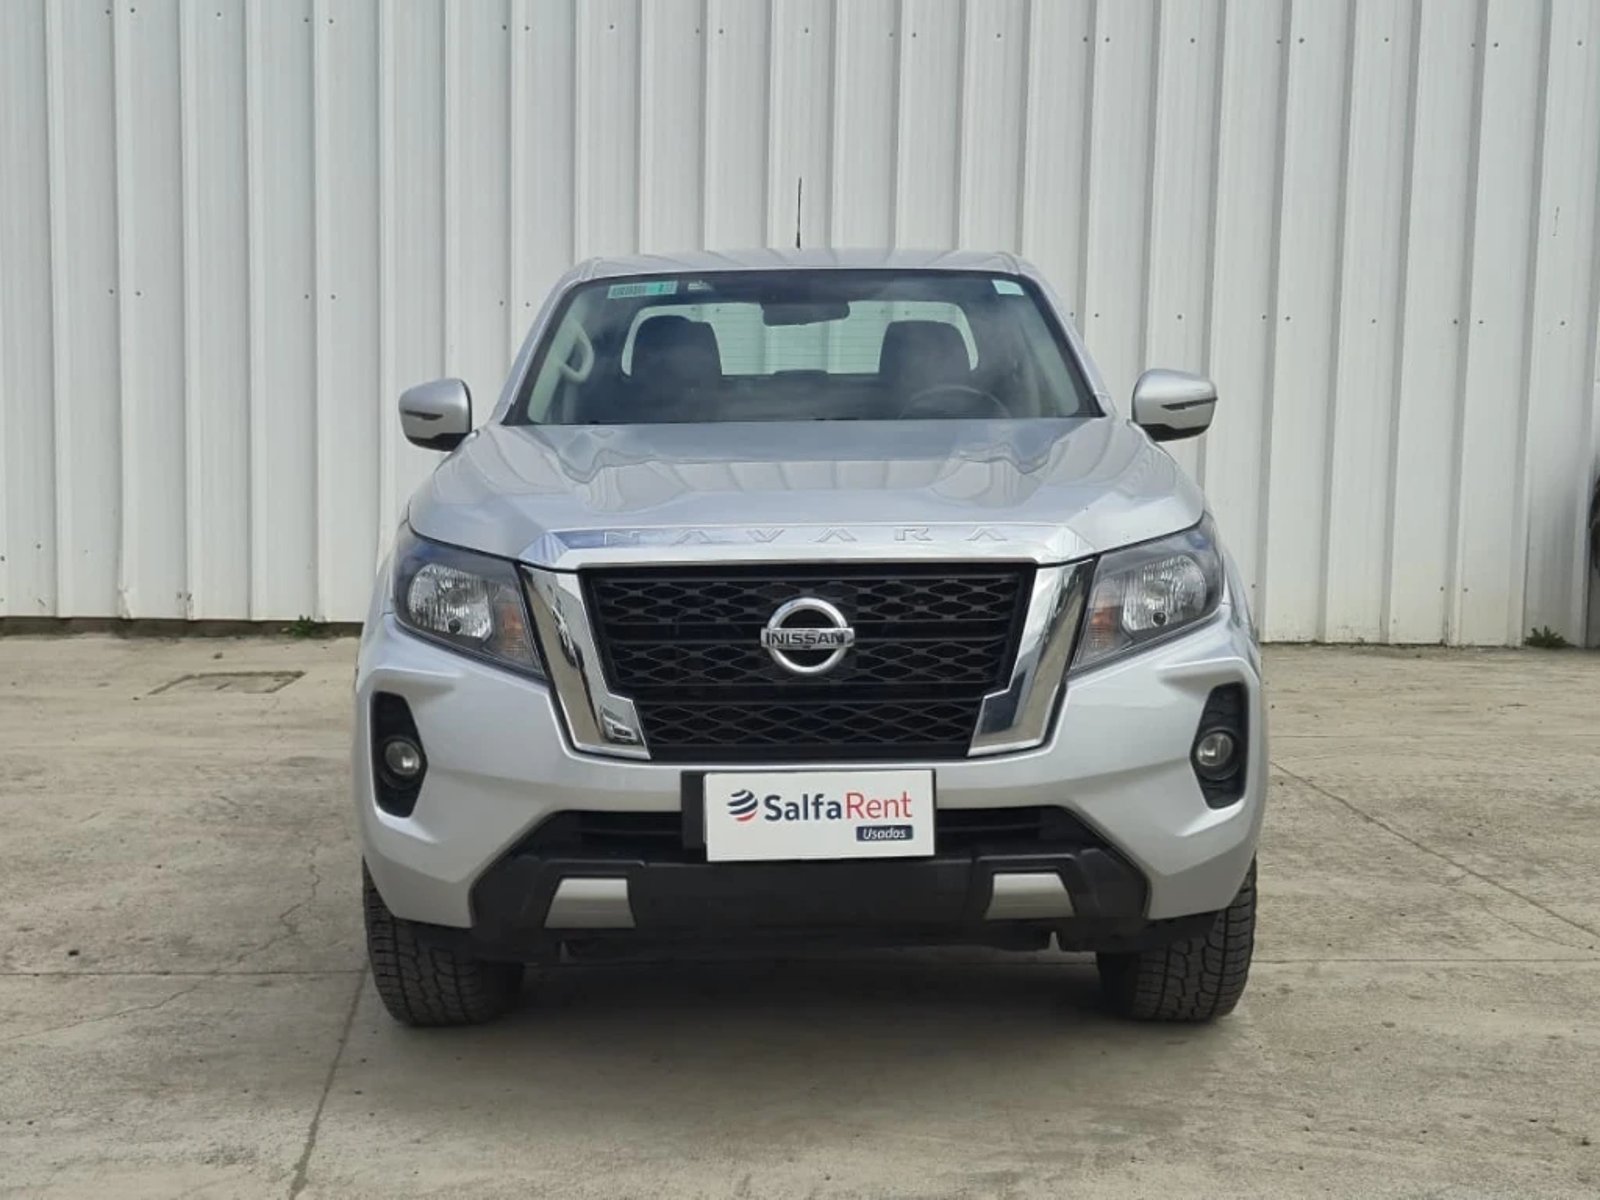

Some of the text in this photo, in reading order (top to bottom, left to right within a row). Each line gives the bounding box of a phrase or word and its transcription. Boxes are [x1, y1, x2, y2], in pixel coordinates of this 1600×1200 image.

[603, 526, 1008, 546] NAVARA
[769, 632, 845, 645] NISSAN
[764, 791, 914, 821] SalfaRent
[862, 827, 907, 841] Usados
